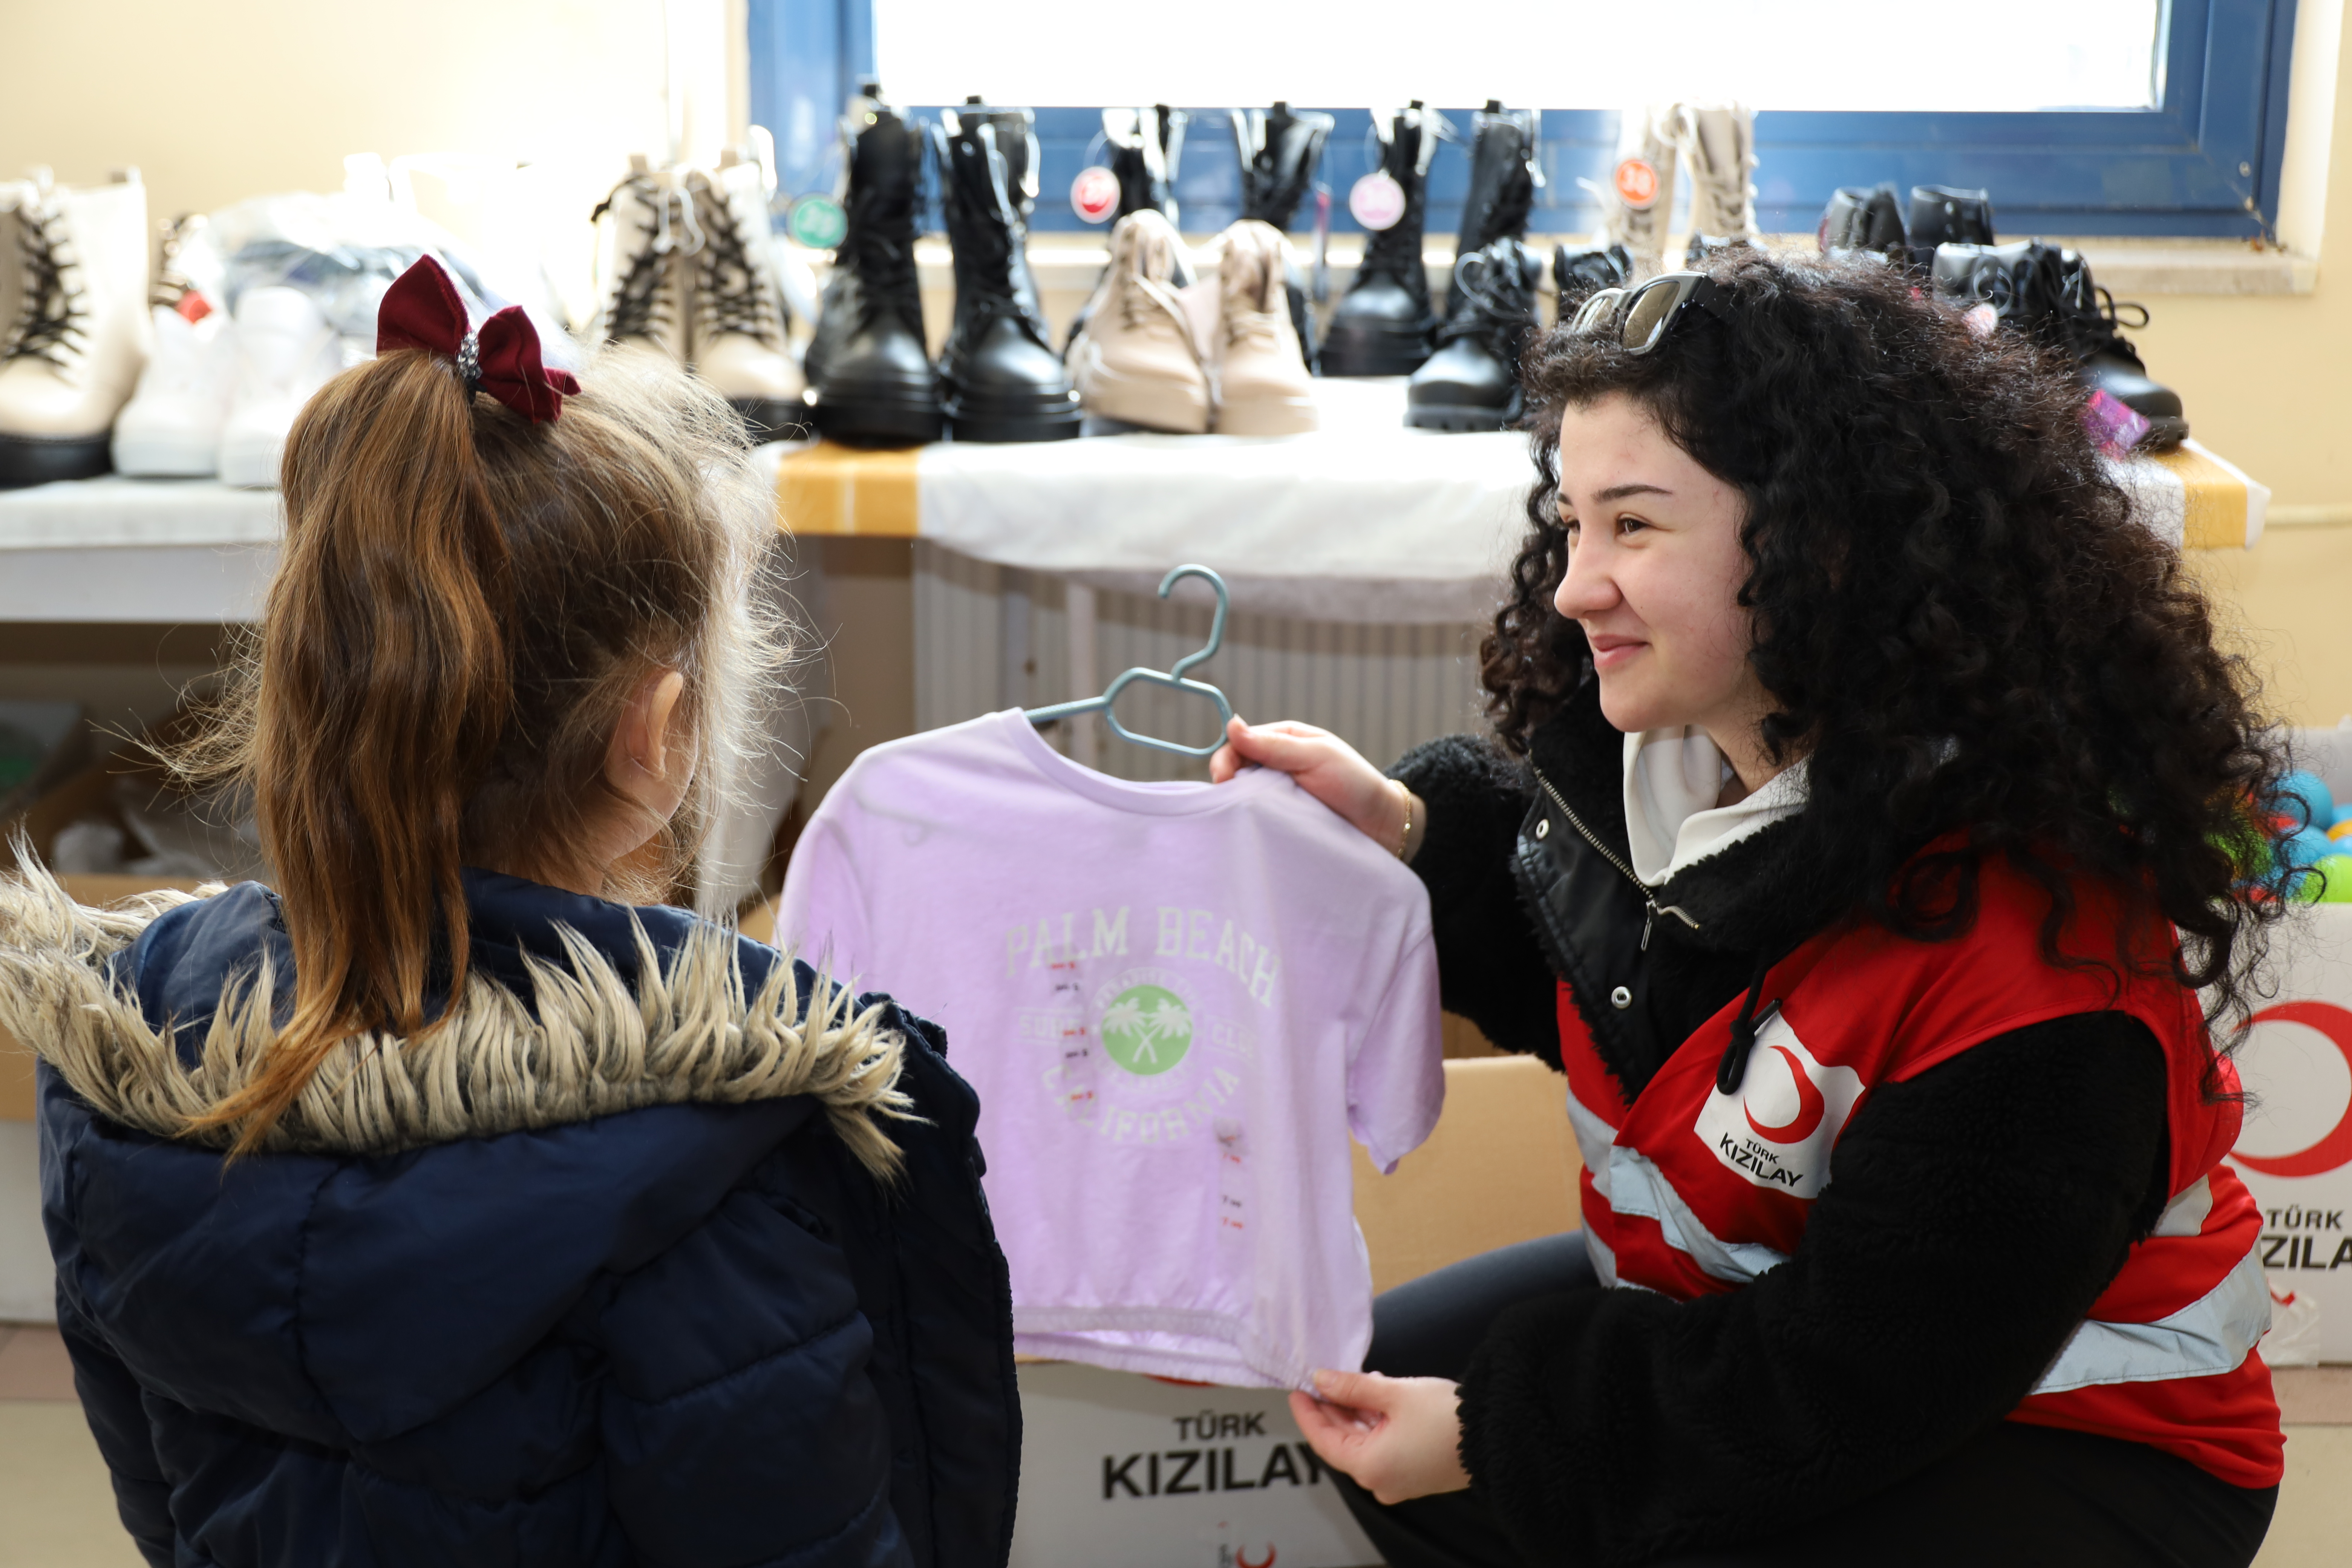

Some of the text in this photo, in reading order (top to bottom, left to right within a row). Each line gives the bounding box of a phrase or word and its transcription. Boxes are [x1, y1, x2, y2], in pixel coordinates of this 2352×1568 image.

[1005, 905, 1131, 980] PALM
[1155, 906, 1280, 1008] BEACH
[1042, 1064, 1240, 1144] CALIFORNIA
[1720, 1132, 1804, 1187] KIZILAY
[1746, 1138, 1779, 1164] TÜRK
[2266, 1204, 2343, 1231] TÜRK
[2261, 1235, 2352, 1269] ZILA
[1173, 1409, 1267, 1441] TÜRK
